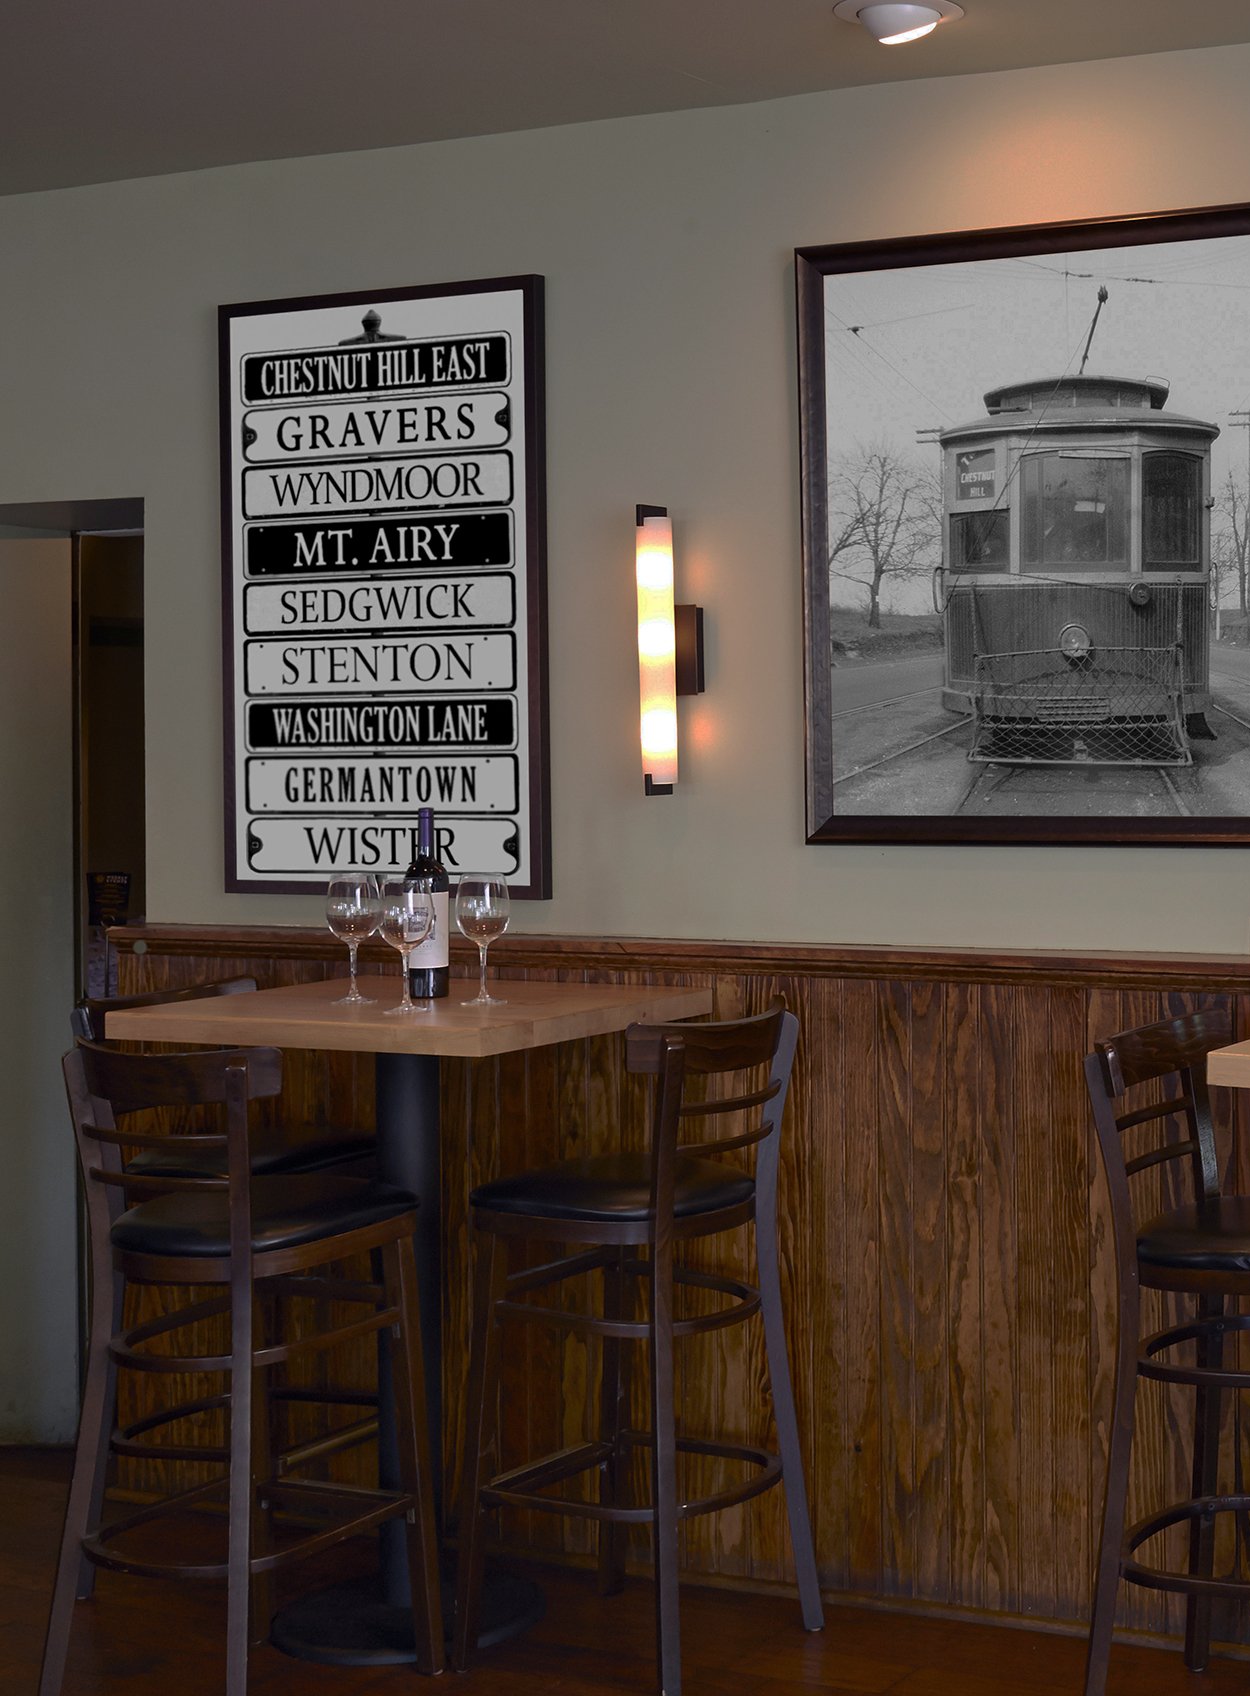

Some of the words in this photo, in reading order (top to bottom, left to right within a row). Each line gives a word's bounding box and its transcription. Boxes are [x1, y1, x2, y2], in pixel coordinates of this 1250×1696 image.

[261, 353, 371, 395] CHESTNUT
[377, 349, 425, 386] HILL
[432, 342, 489, 381] EAST
[277, 403, 475, 451] GRAVERS
[270, 462, 484, 506] WYNDMOOR
[961, 470, 995, 483] CHESTNUT
[970, 487, 986, 497] HILL
[294, 529, 358, 566] MT.
[369, 524, 459, 563] AIRY
[281, 584, 475, 624] SEDGWICK
[283, 643, 473, 684] STENTON
[273, 706, 420, 743] WASHINGTON
[428, 705, 487, 741] LANE
[285, 766, 476, 802] GERMANTOWN
